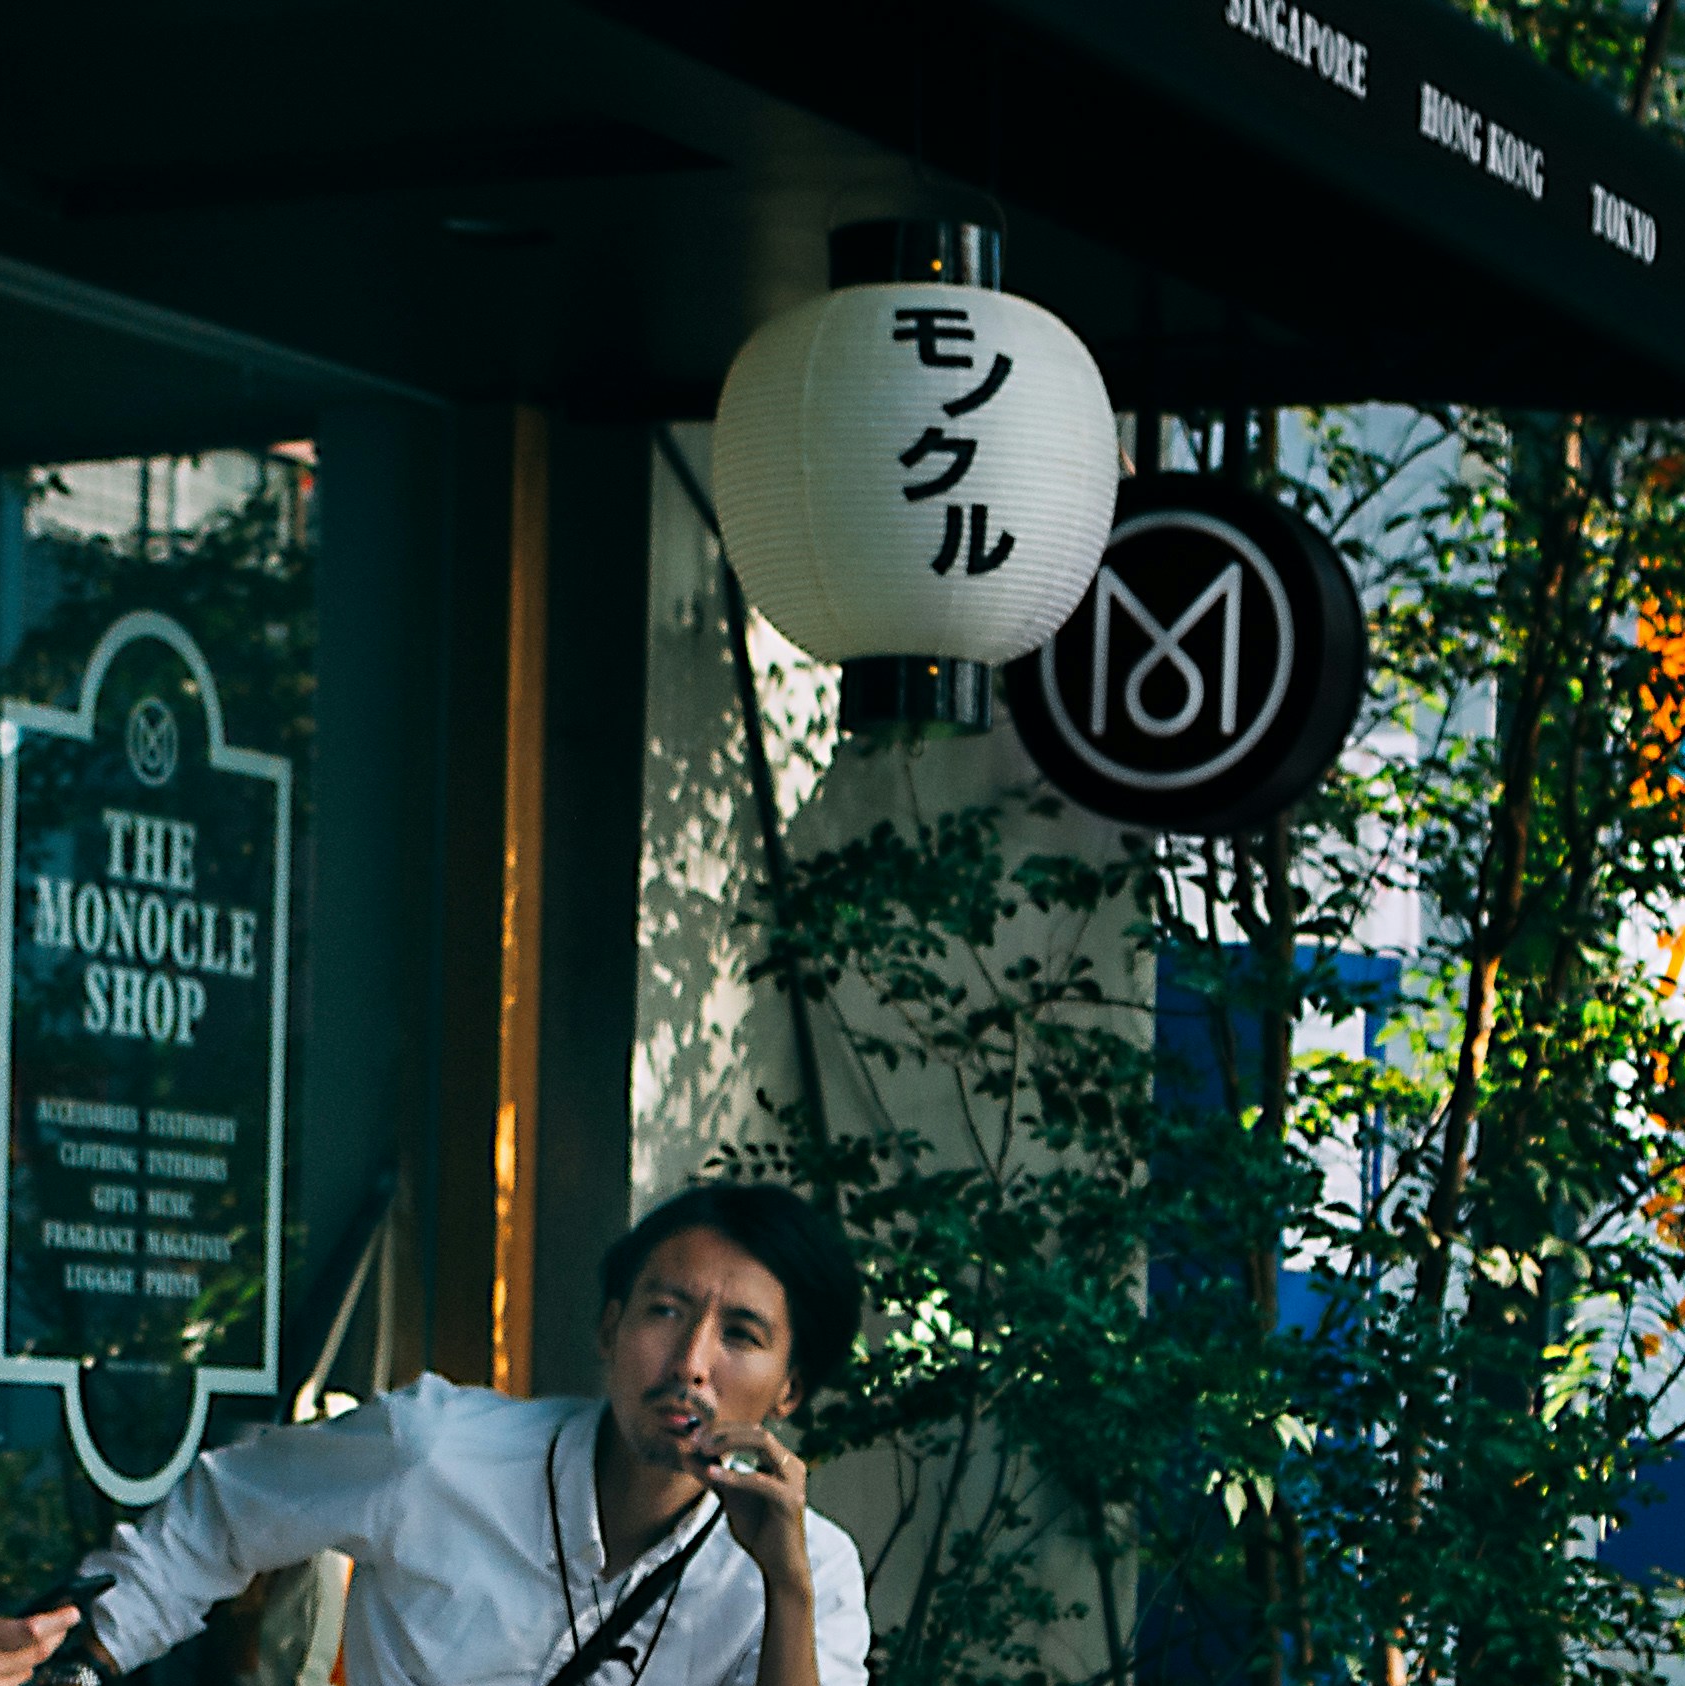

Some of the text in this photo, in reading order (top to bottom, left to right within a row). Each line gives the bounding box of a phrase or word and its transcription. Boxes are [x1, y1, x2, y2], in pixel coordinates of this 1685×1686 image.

[1420, 81, 1545, 202] HONG KONG
[1591, 182, 1658, 266] TOKYO
[893, 309, 1015, 577] モノクル
[103, 807, 196, 893] THE
[33, 876, 257, 979] MONOCLE
[83, 960, 207, 1046] SHOP
